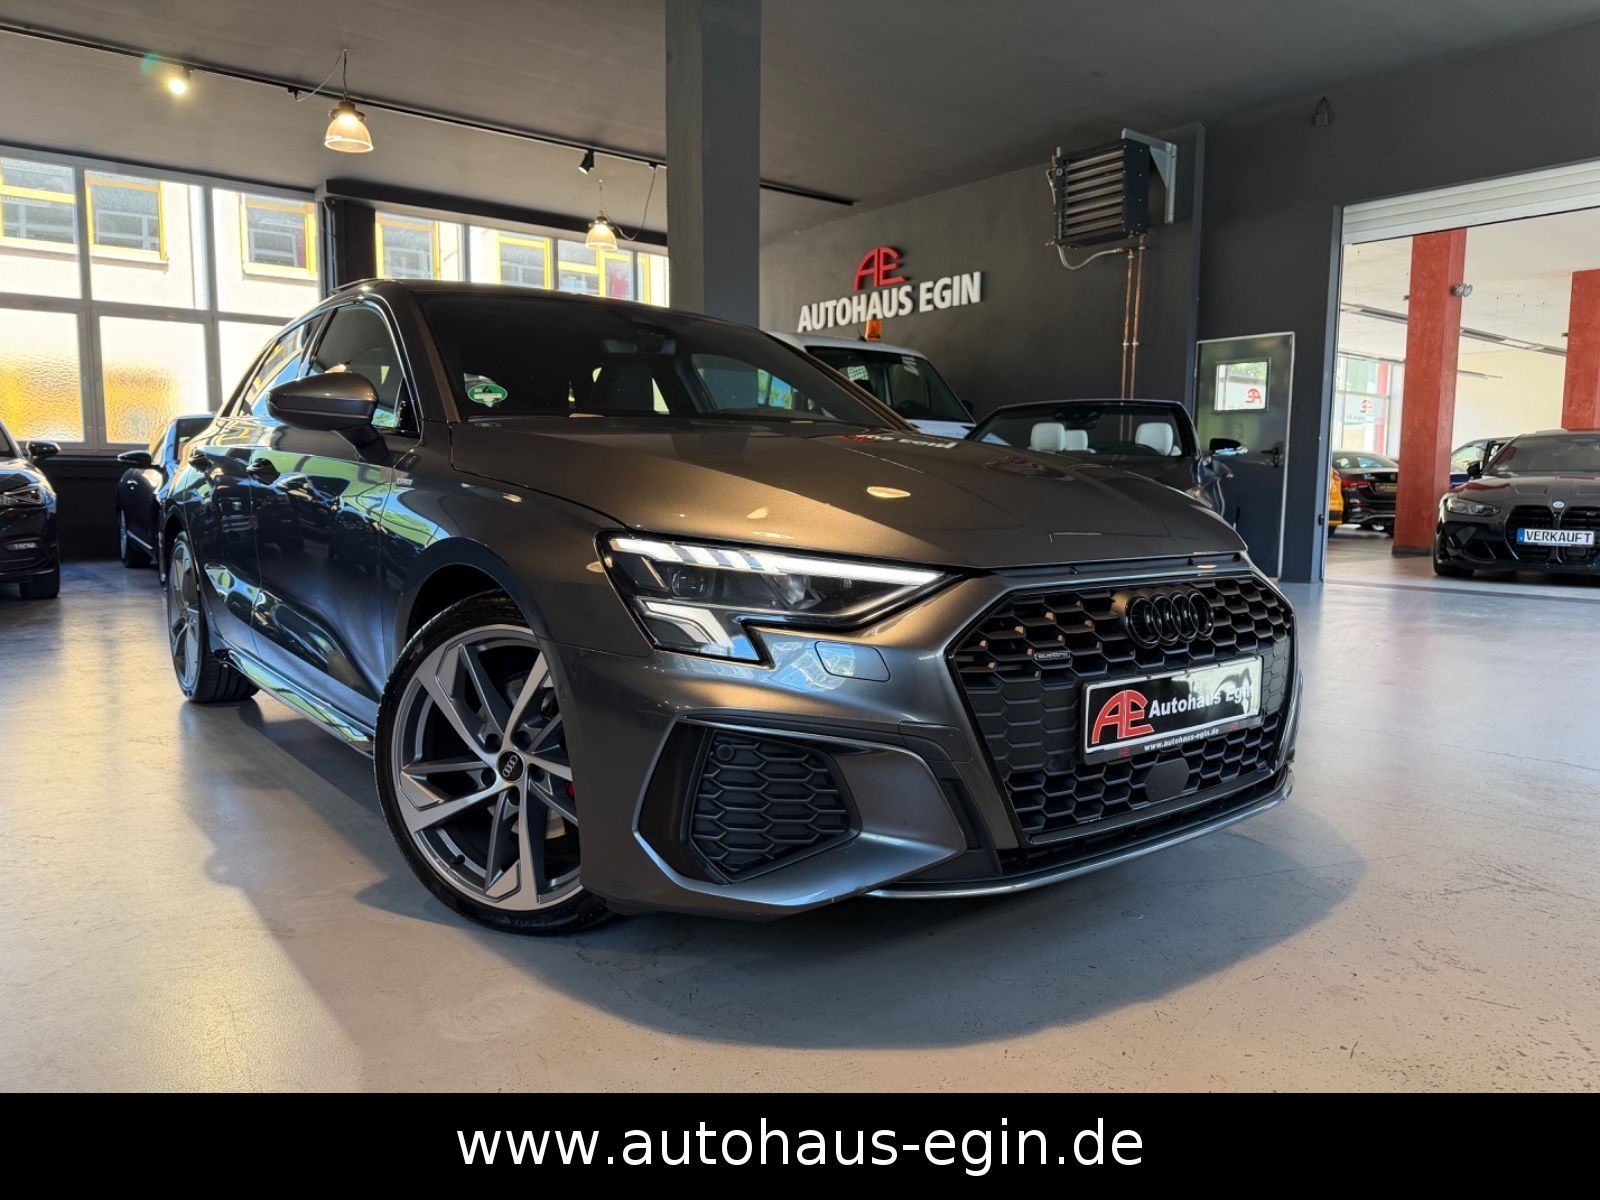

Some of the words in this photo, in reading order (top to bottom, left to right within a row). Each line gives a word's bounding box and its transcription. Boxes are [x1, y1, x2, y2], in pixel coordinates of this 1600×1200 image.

[797, 285, 913, 333] AUTOHAUS
[919, 271, 981, 312] EGIN
[1526, 530, 1592, 543] VERKAUFT
[1148, 692, 1221, 718] Autohaus
[1143, 727, 1220, 752] www.autohaus-egin.de
